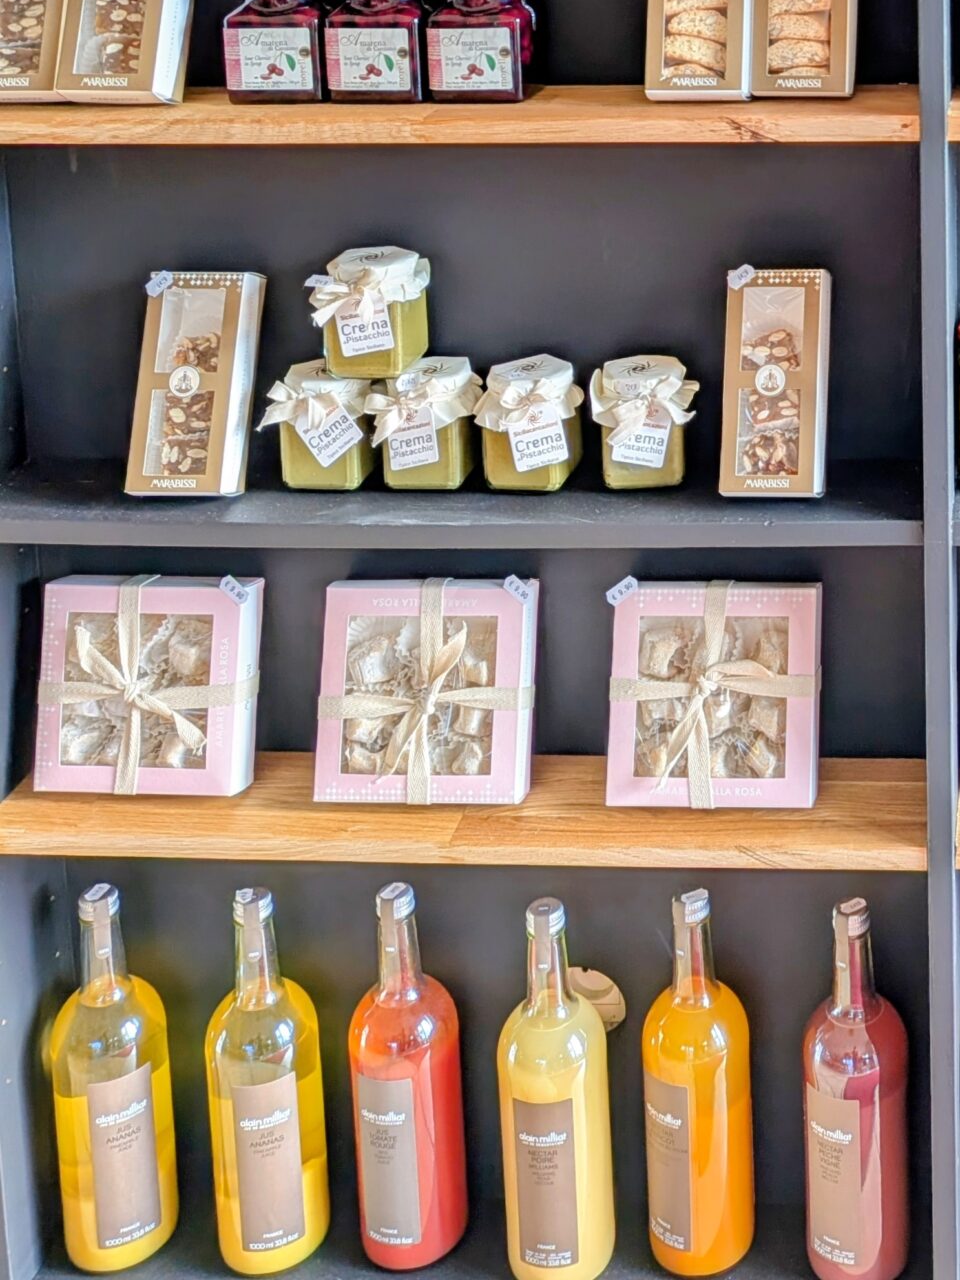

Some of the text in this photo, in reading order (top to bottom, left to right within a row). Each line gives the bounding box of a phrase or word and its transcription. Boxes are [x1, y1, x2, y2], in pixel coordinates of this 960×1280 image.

[80, 77, 128, 87] MARABISSI
[670, 77, 717, 86] MARABISSI
[775, 78, 821, 88] MARABISSI
[308, 413, 349, 450] Crema
[390, 432, 433, 449] Crema
[514, 431, 563, 453] Crema
[150, 479, 197, 488] MARABISSI
[744, 479, 790, 489] MARABISSI
[617, 581, 633, 596] 9.90
[96, 1099, 148, 1125] alain milliat
[360, 1109, 406, 1123] alain milliat
[240, 1109, 292, 1131] alain milliat
[519, 1130, 567, 1142] alain milliat
[810, 1120, 853, 1143] alain milliat
